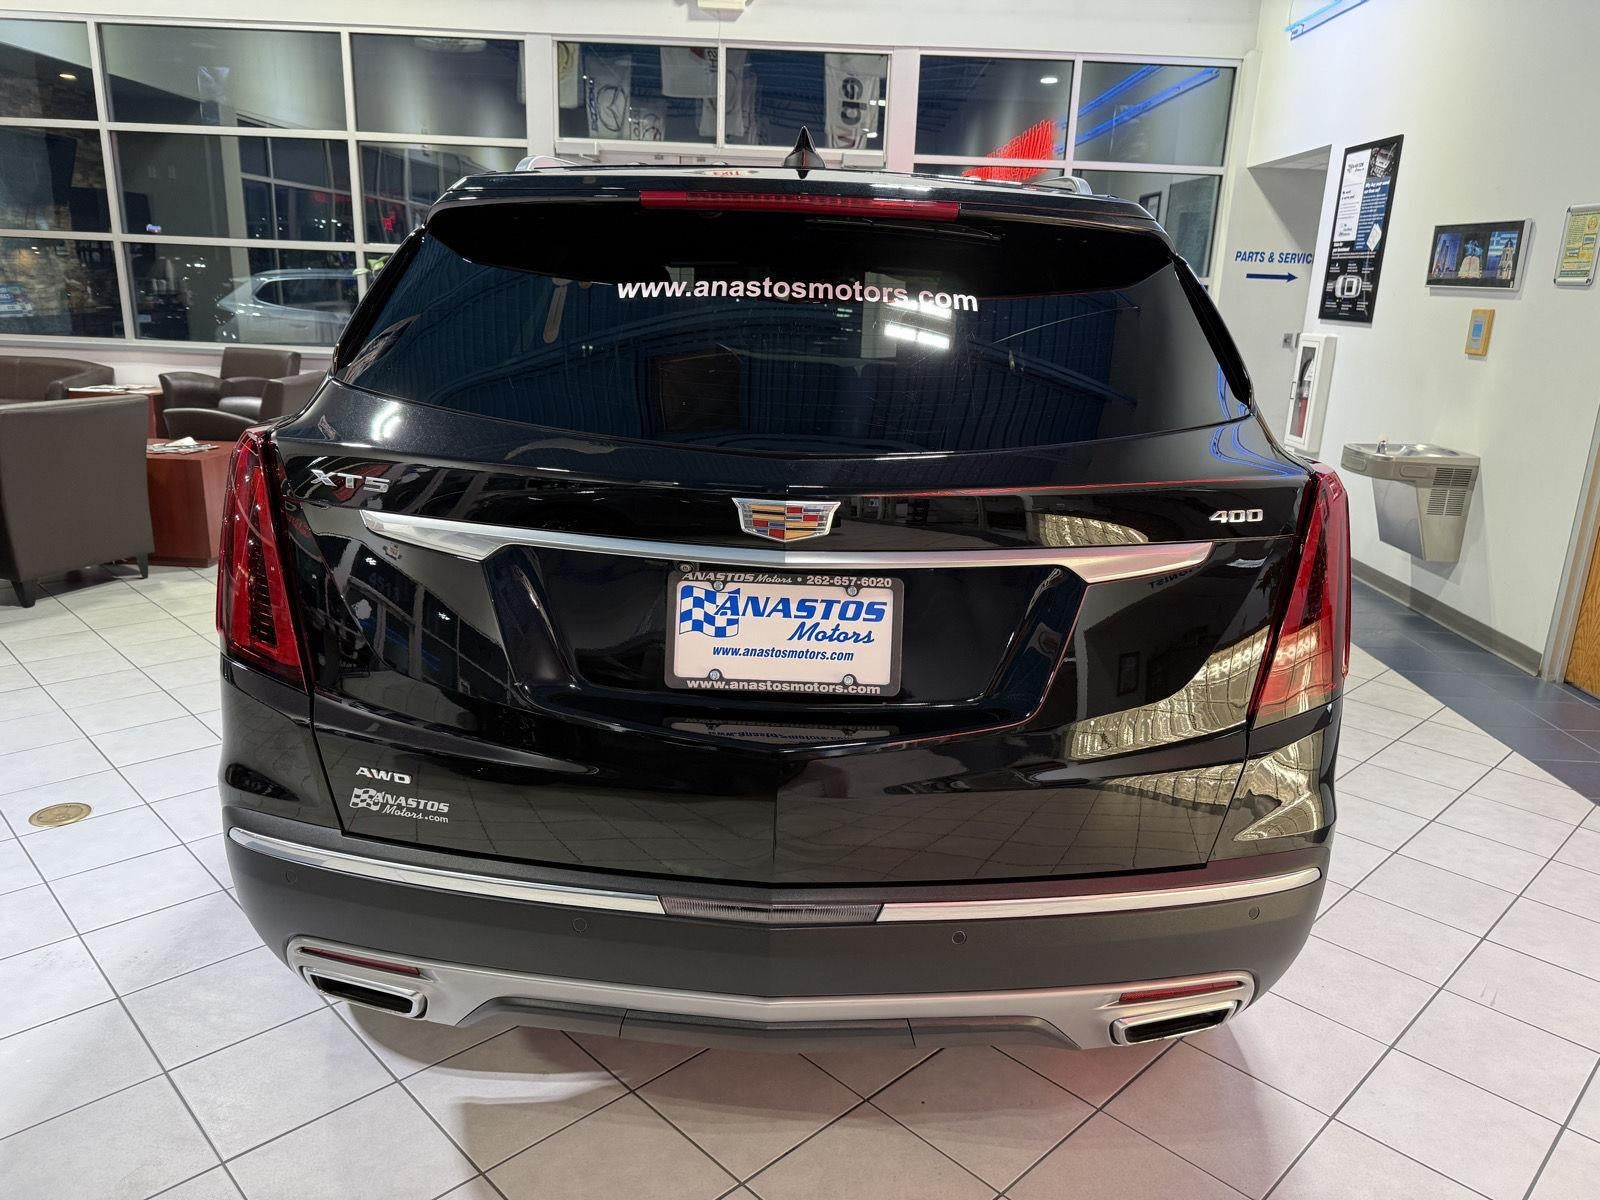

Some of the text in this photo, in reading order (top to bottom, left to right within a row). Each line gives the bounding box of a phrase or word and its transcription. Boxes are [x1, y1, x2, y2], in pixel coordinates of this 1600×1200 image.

[1235, 250, 1314, 264] PARTS & SERVIC
[617, 277, 979, 311] www.anastosmotors.com
[310, 469, 390, 493] XT5
[1208, 508, 1264, 523] 400
[681, 572, 892, 588] ANASTOS Motors 262-657-6020
[713, 591, 888, 623] ANASTOS
[787, 621, 875, 644] Motors
[712, 646, 854, 662] www.anastosmotors.com
[686, 678, 881, 695] www.anastosmotors.com
[356, 766, 411, 784] AWD
[372, 791, 450, 813] ANASTOS
